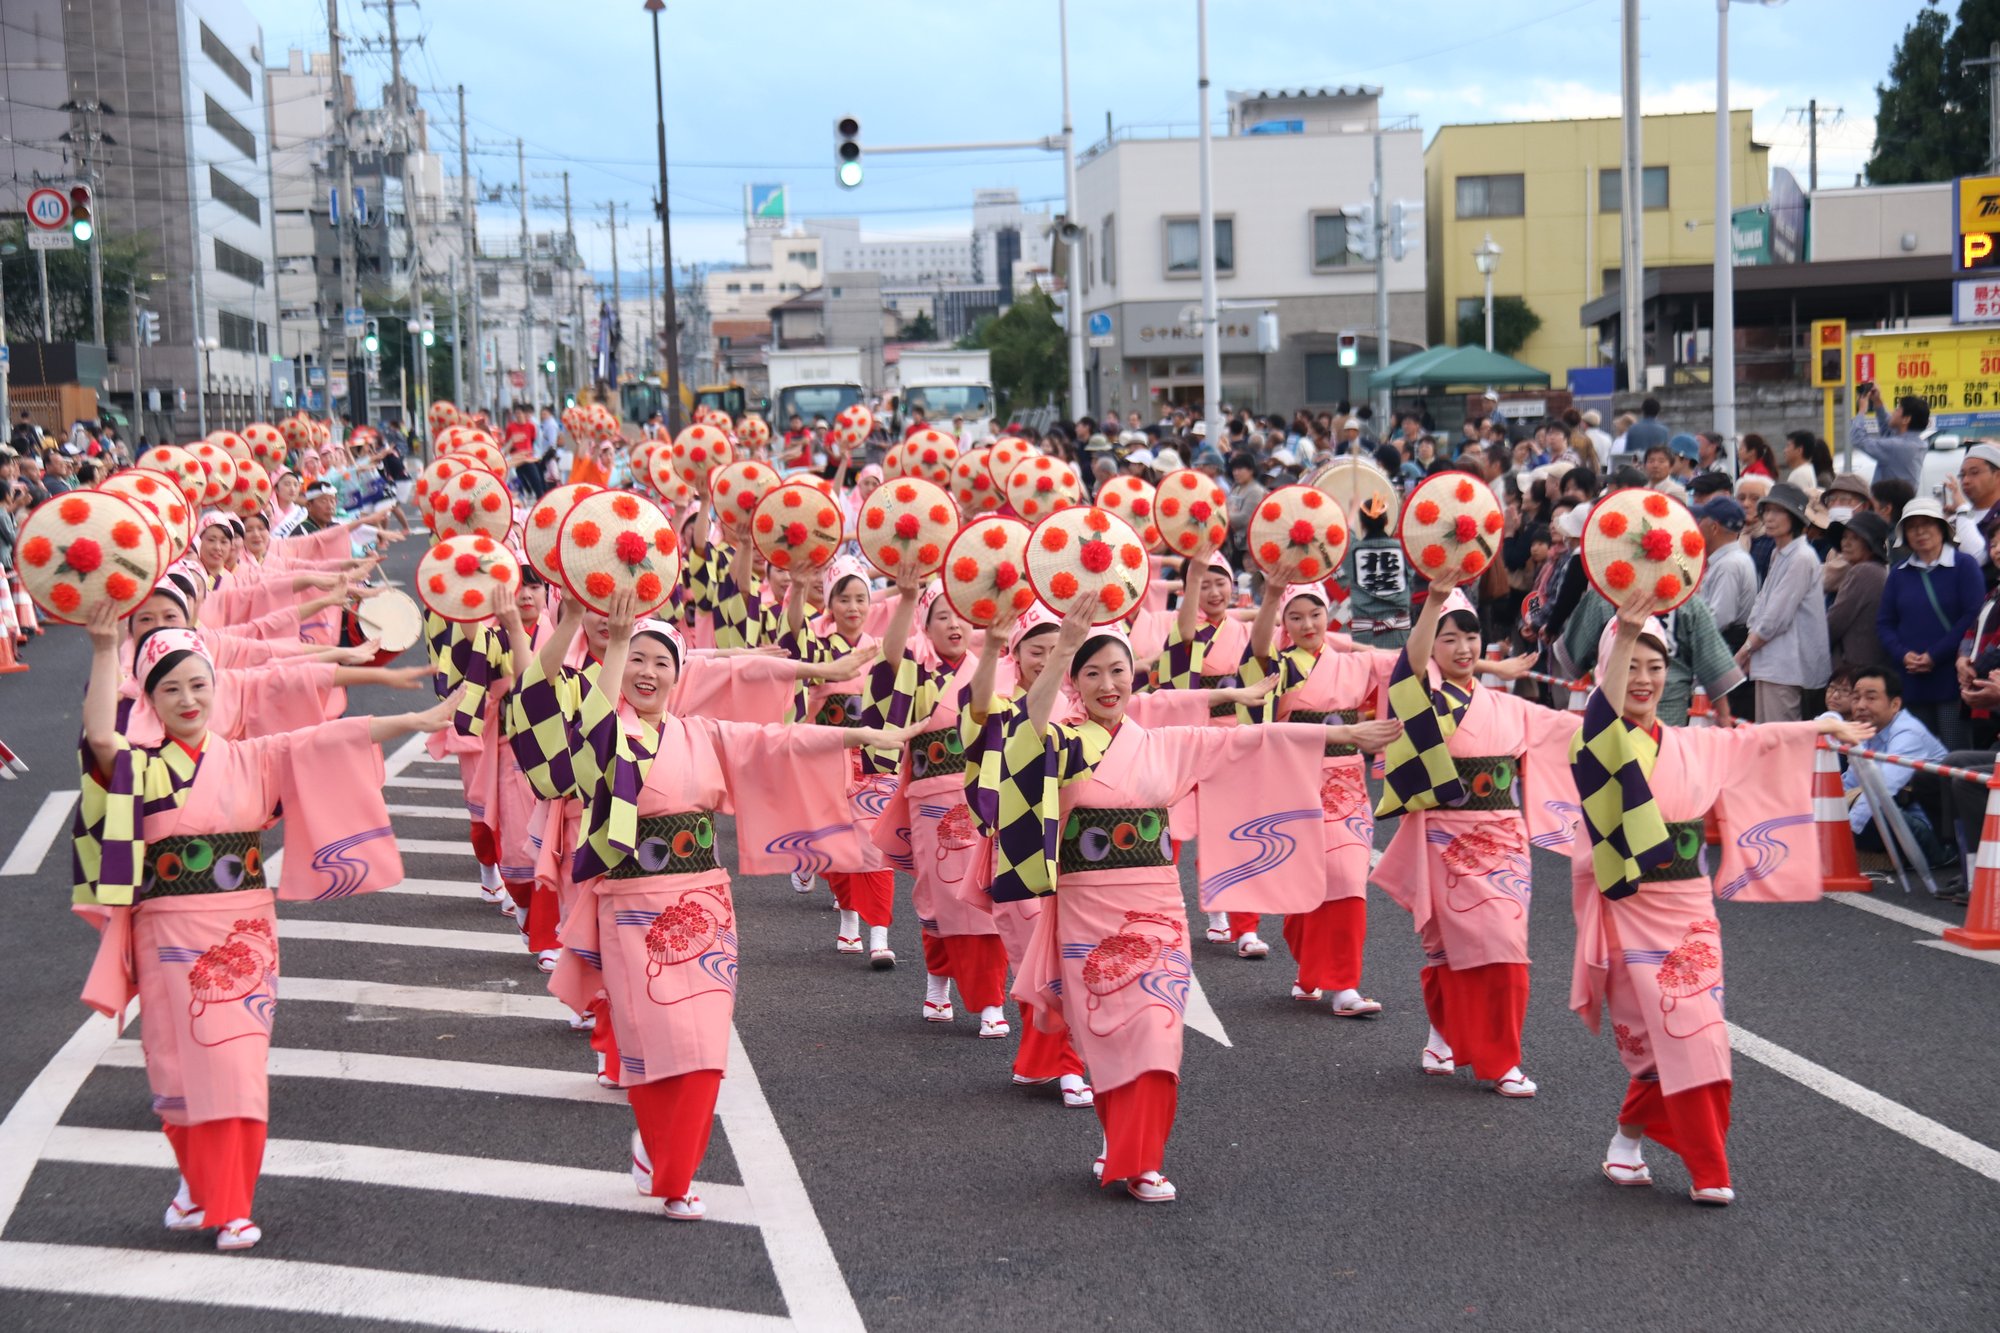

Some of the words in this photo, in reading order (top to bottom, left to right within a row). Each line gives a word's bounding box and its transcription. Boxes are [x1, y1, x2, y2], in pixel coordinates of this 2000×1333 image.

[37, 199, 60, 219] 40
[32, 235, 70, 247] ここから
[1964, 232, 1993, 268] P
